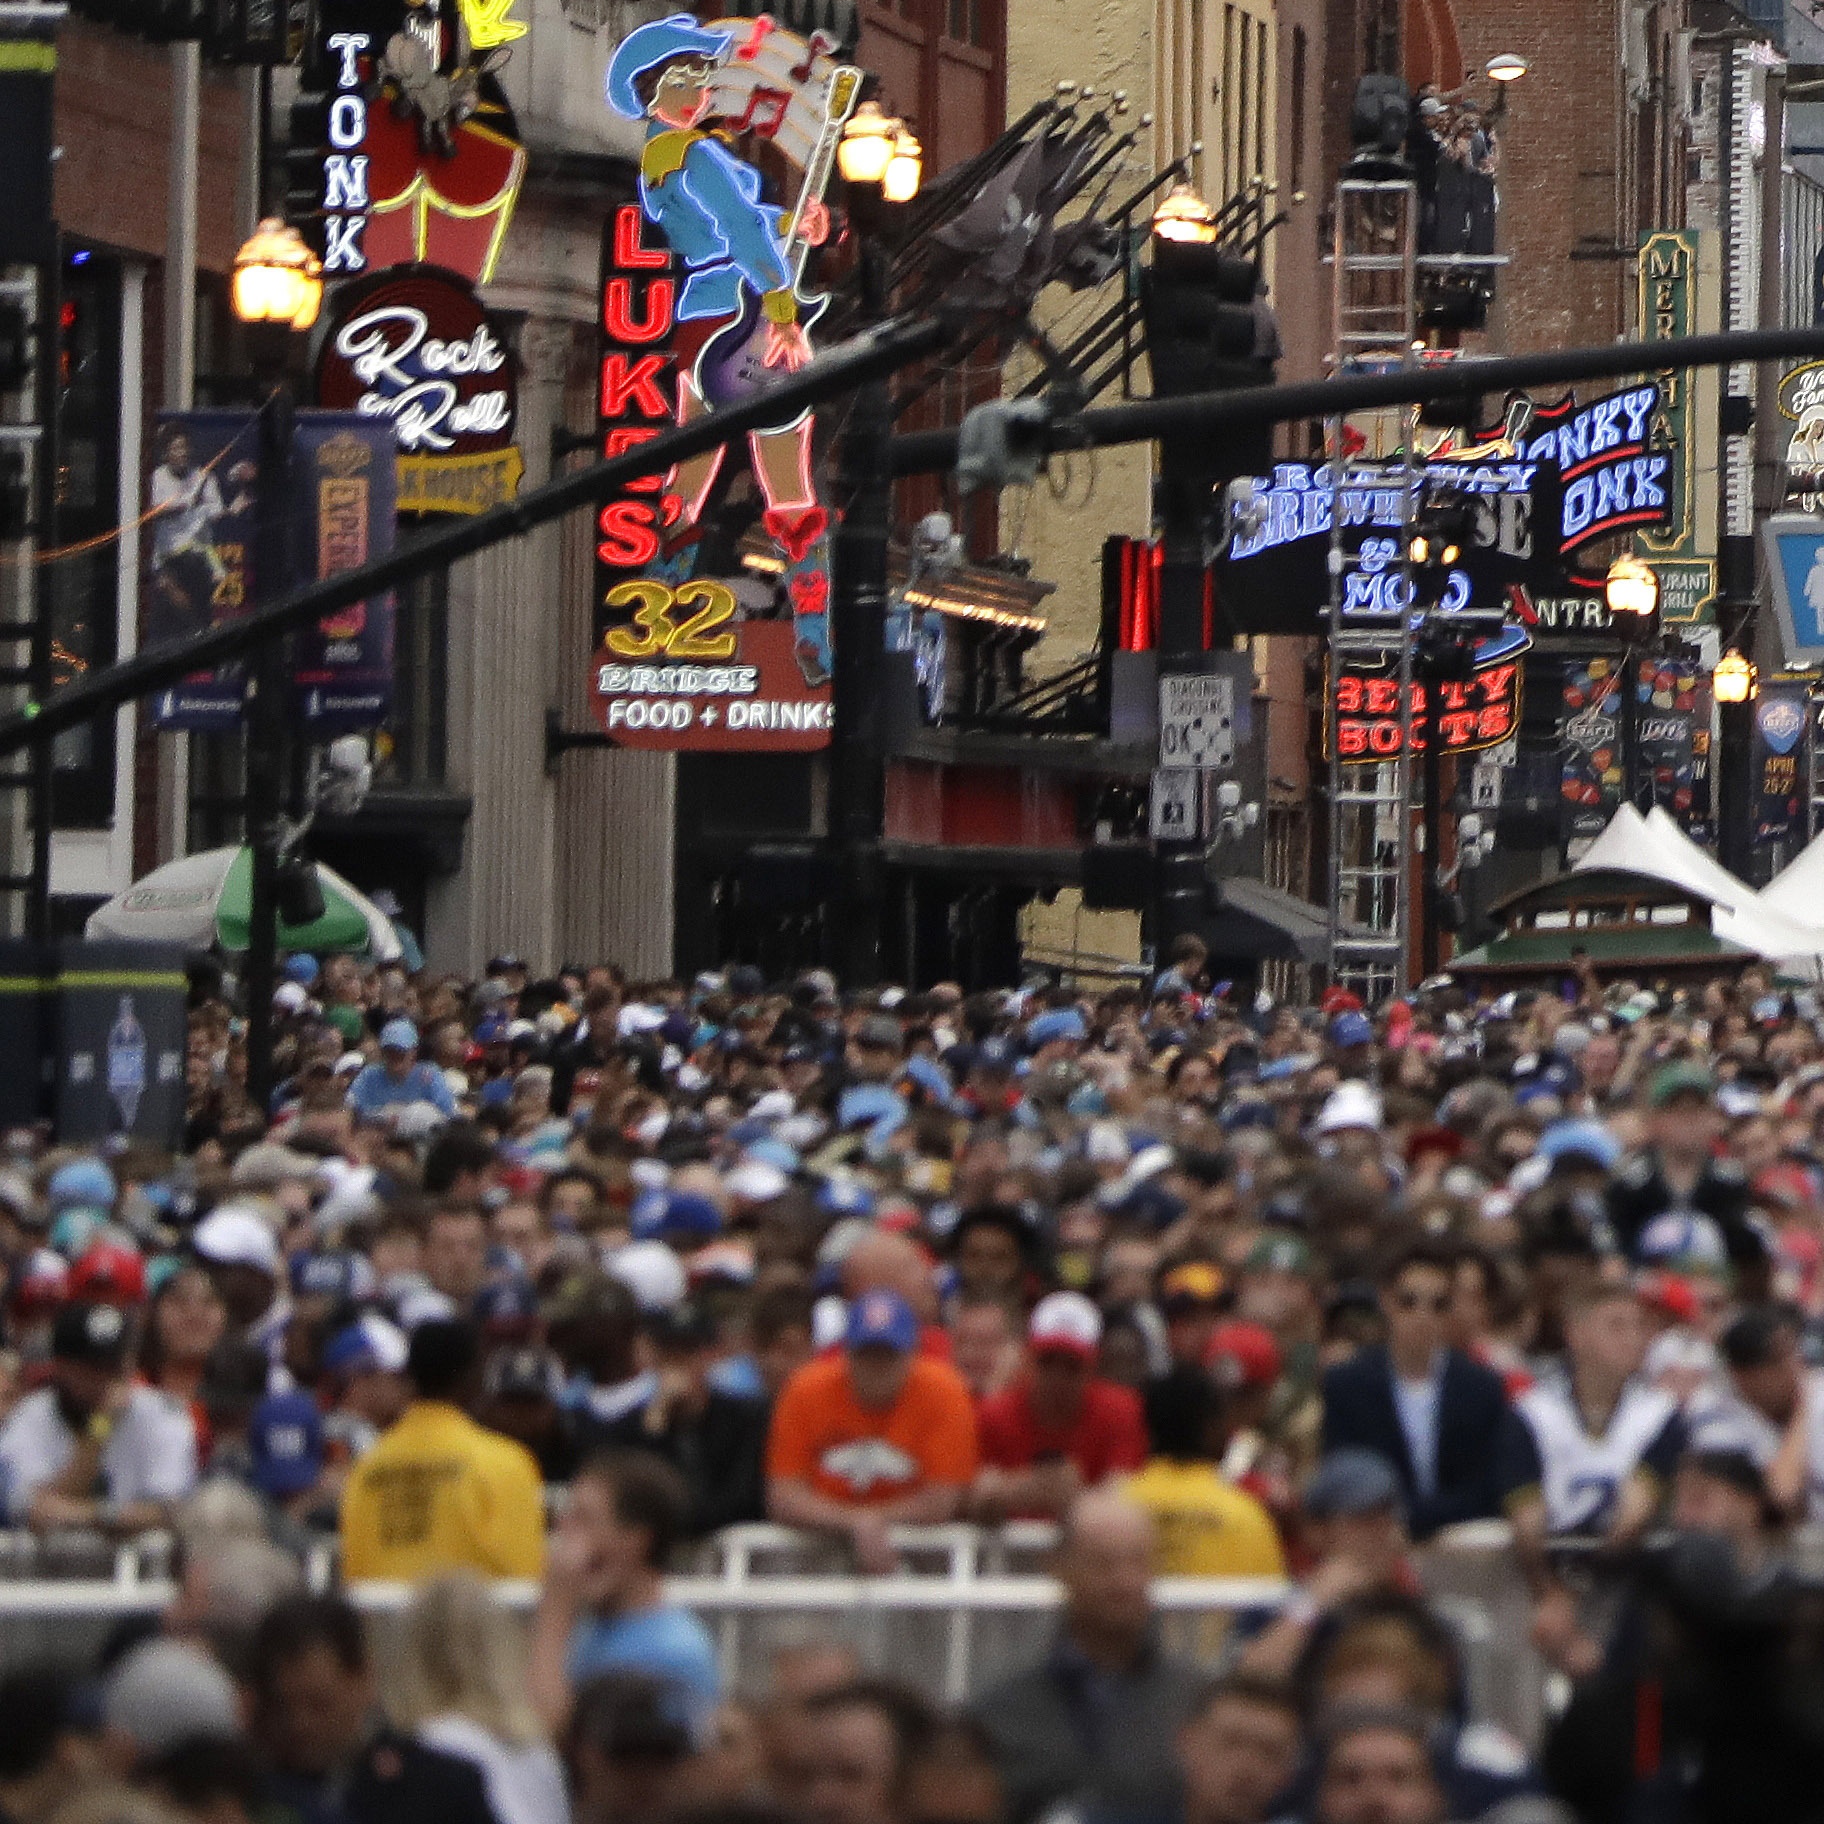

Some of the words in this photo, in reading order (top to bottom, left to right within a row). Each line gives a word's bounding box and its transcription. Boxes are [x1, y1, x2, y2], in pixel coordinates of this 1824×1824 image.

[321, 31, 370, 274] TONK
[604, 579, 737, 658] 32
[599, 663, 759, 694] BRIDGE
[608, 698, 694, 729] FOOD
